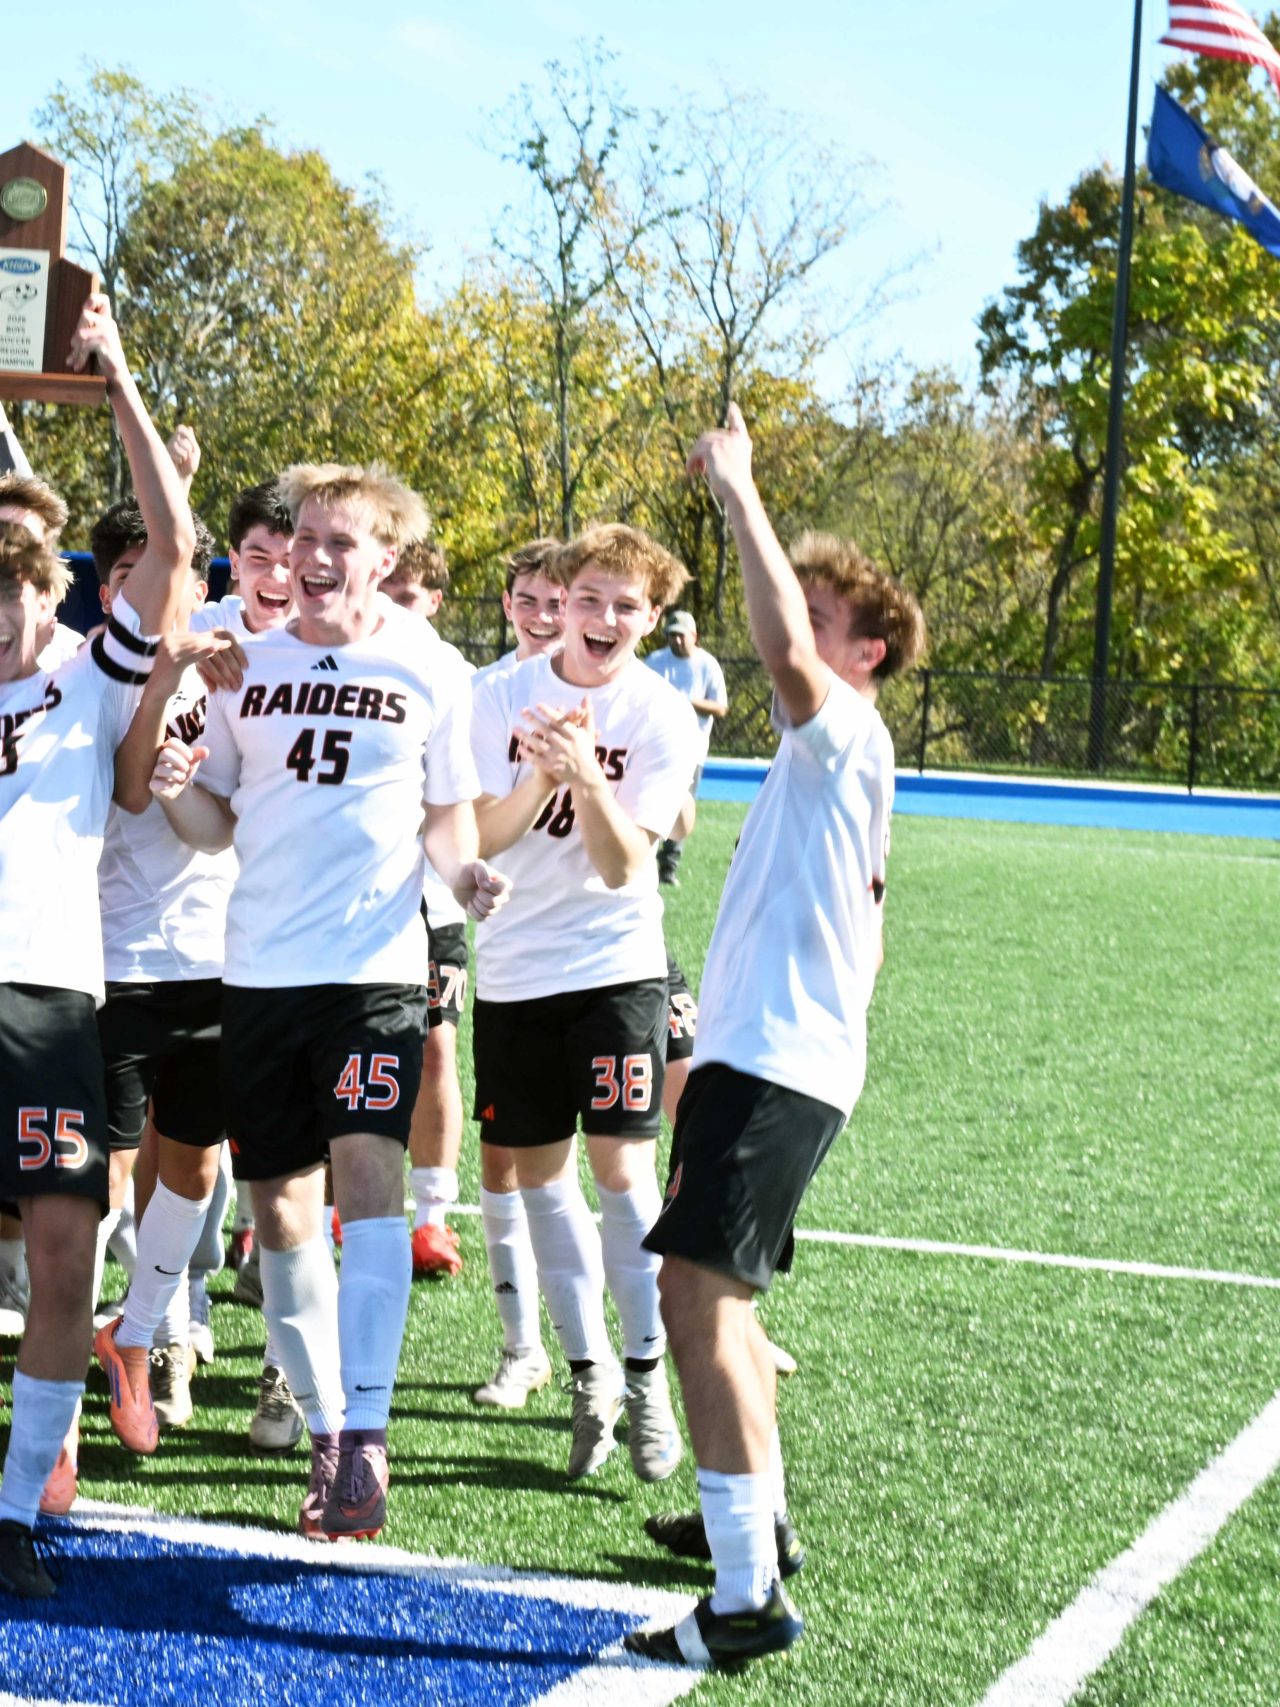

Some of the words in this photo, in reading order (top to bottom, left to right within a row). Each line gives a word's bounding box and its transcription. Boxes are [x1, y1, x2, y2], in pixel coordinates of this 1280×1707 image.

[0, 336, 31, 345] SOCCER
[0, 346, 29, 356] REGION
[5, 325, 26, 334] BOYS
[240, 682, 407, 724] RAIDERS
[286, 728, 353, 785] 45
[440, 965, 468, 1012] 70
[333, 1053, 400, 1110] 45
[591, 1053, 652, 1111] 38
[18, 1106, 88, 1171] 55
